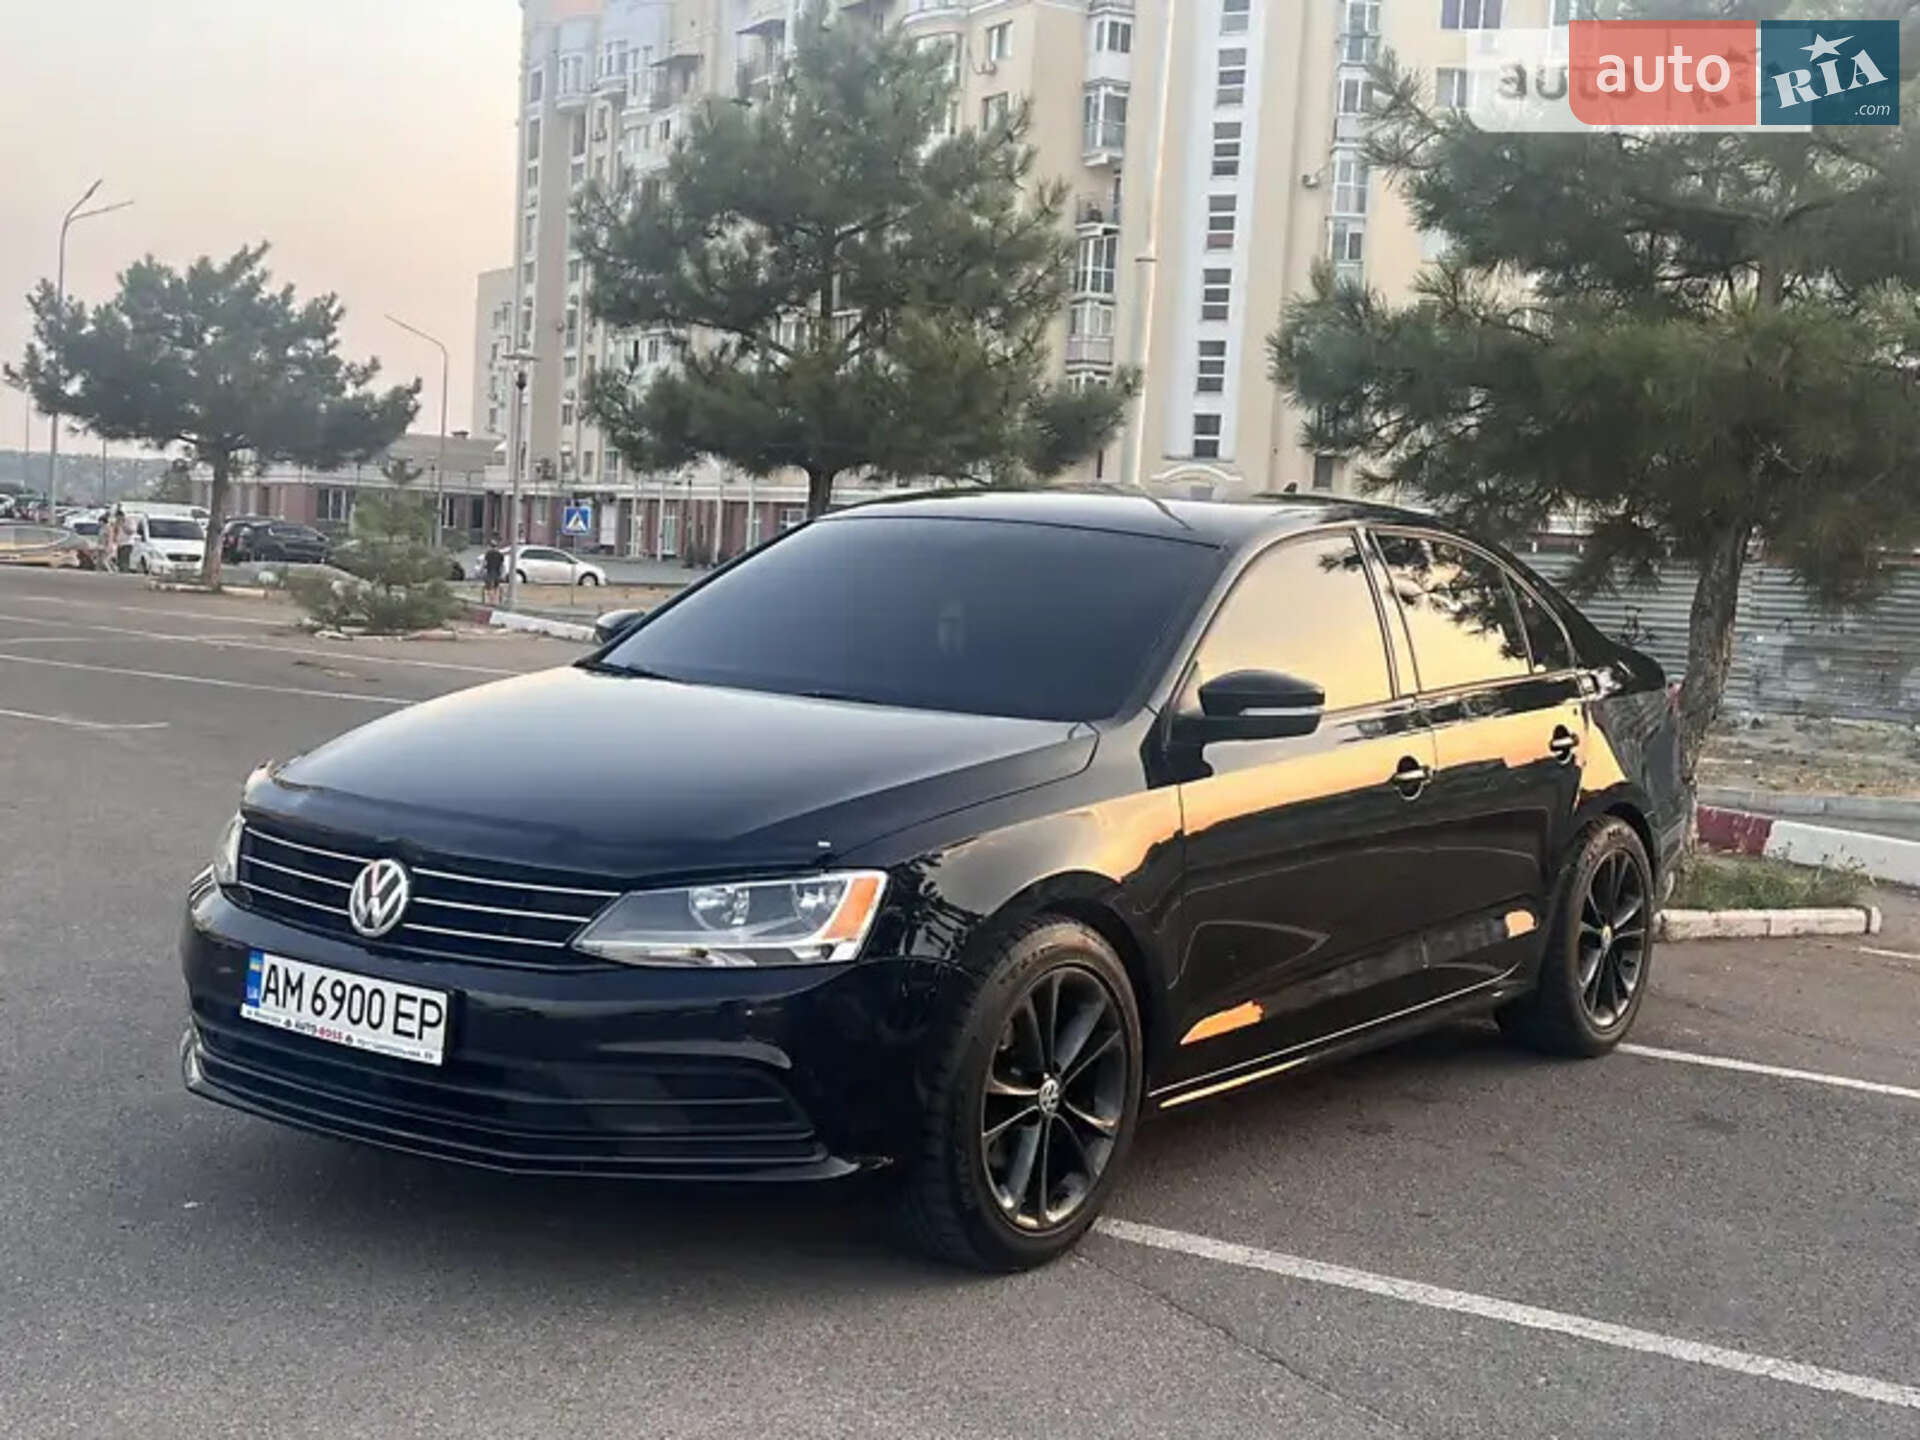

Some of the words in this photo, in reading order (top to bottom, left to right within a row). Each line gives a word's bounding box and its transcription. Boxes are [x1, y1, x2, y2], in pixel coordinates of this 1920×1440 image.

[262, 964, 304, 1012] AM
[311, 976, 385, 1030] 6900
[393, 992, 443, 1040] EP
